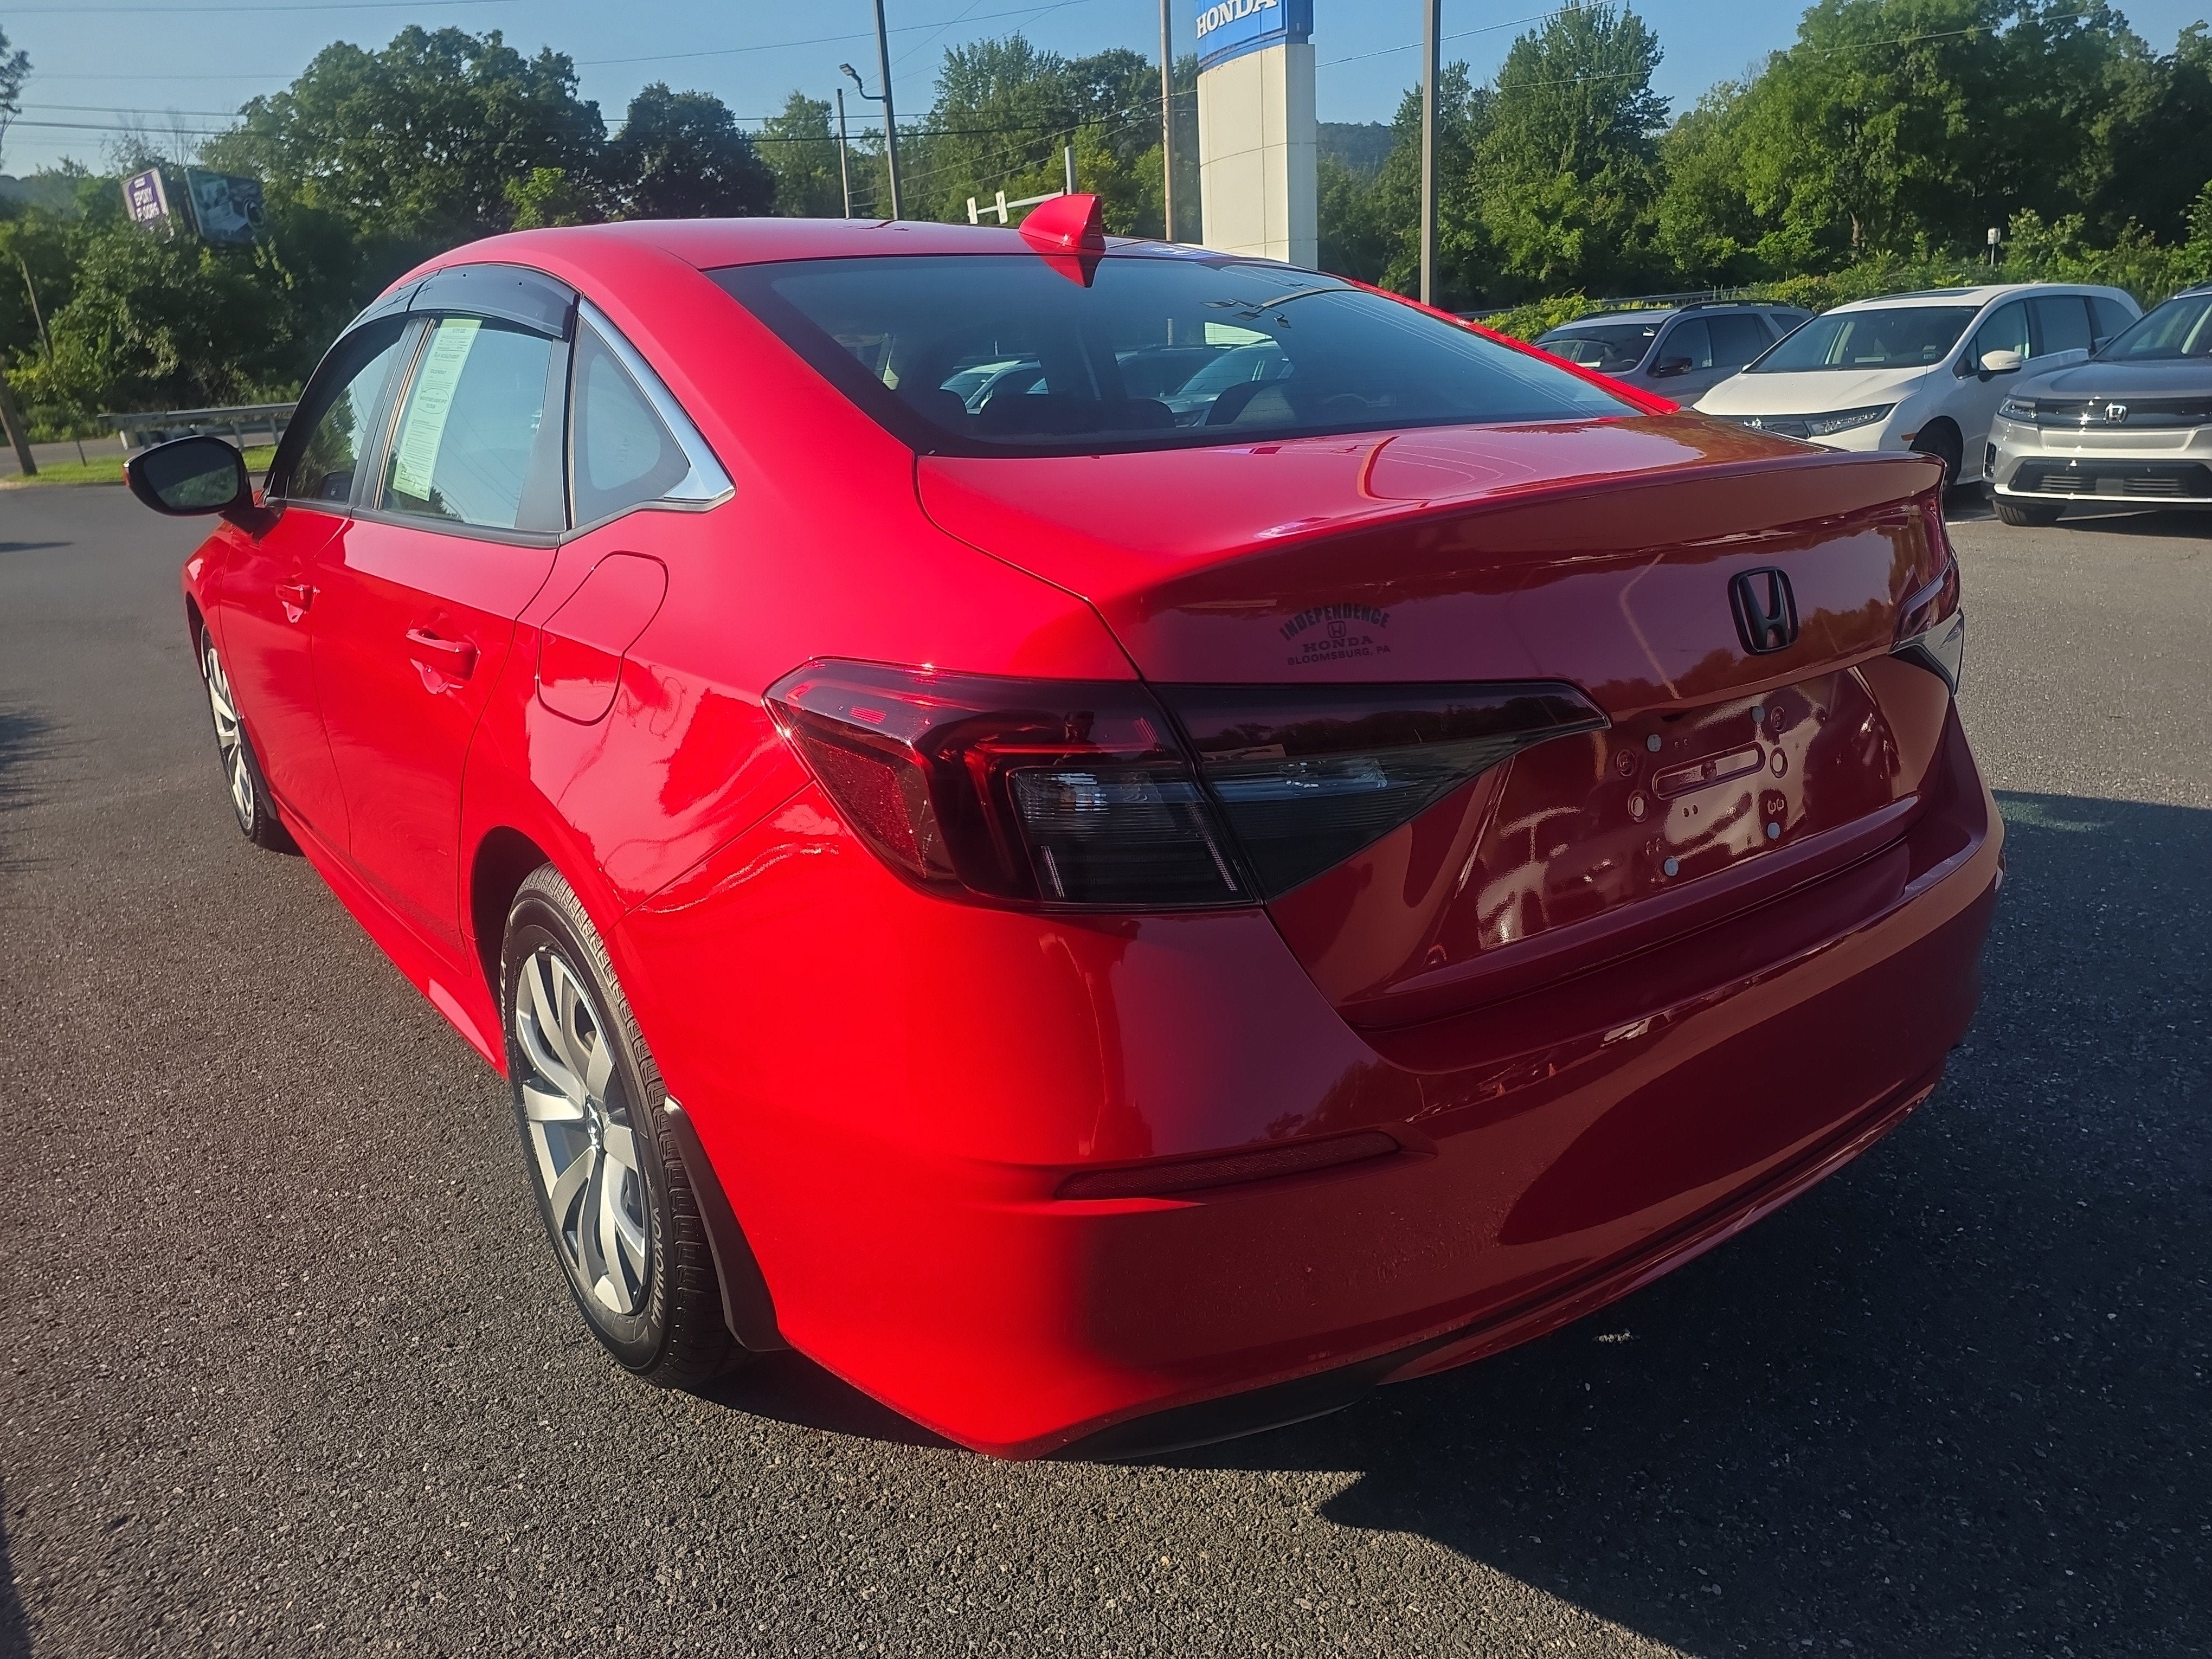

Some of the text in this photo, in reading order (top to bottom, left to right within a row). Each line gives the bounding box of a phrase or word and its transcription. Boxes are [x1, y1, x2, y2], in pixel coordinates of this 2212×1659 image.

[1279, 603, 1390, 641] INDEPENDENCE
[1287, 645, 1391, 666] BLOOMSBURG, PA
[1302, 635, 1374, 653] HONDA
[651, 1207, 664, 1329] YOKOHAMA
